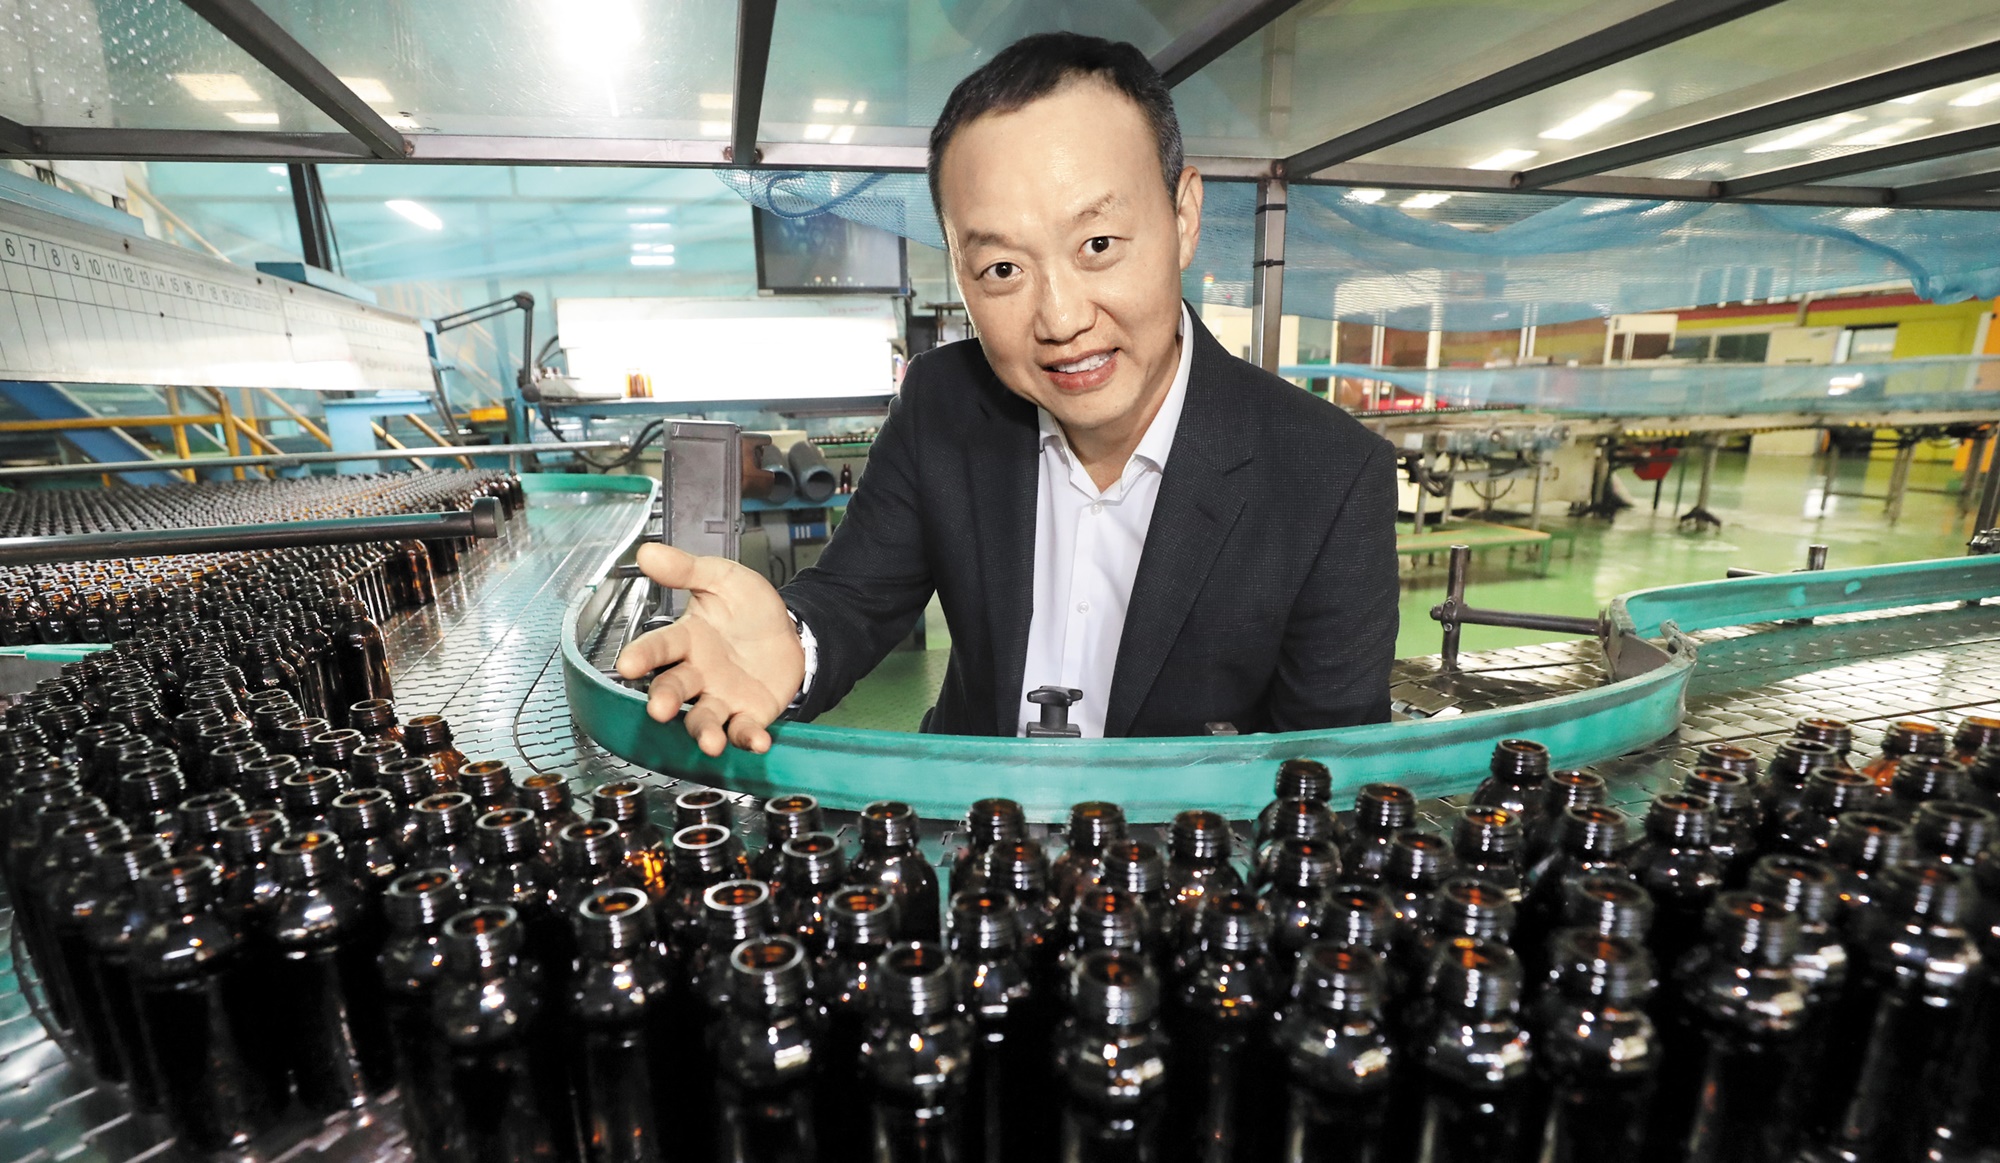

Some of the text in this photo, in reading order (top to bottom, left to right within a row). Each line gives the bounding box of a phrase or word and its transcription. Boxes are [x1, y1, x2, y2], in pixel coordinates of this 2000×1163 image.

[5, 238, 15, 257] 6
[28, 243, 36, 262] 7
[51, 249, 61, 267] 8
[71, 254, 80, 271] 9
[88, 258, 101, 275] 10
[107, 263, 118, 279] 11
[123, 267, 135, 283] 12
[140, 270, 151, 287] 13
[155, 274, 165, 290] 14
[170, 277, 179, 292] 15
[184, 280, 193, 295] 16
